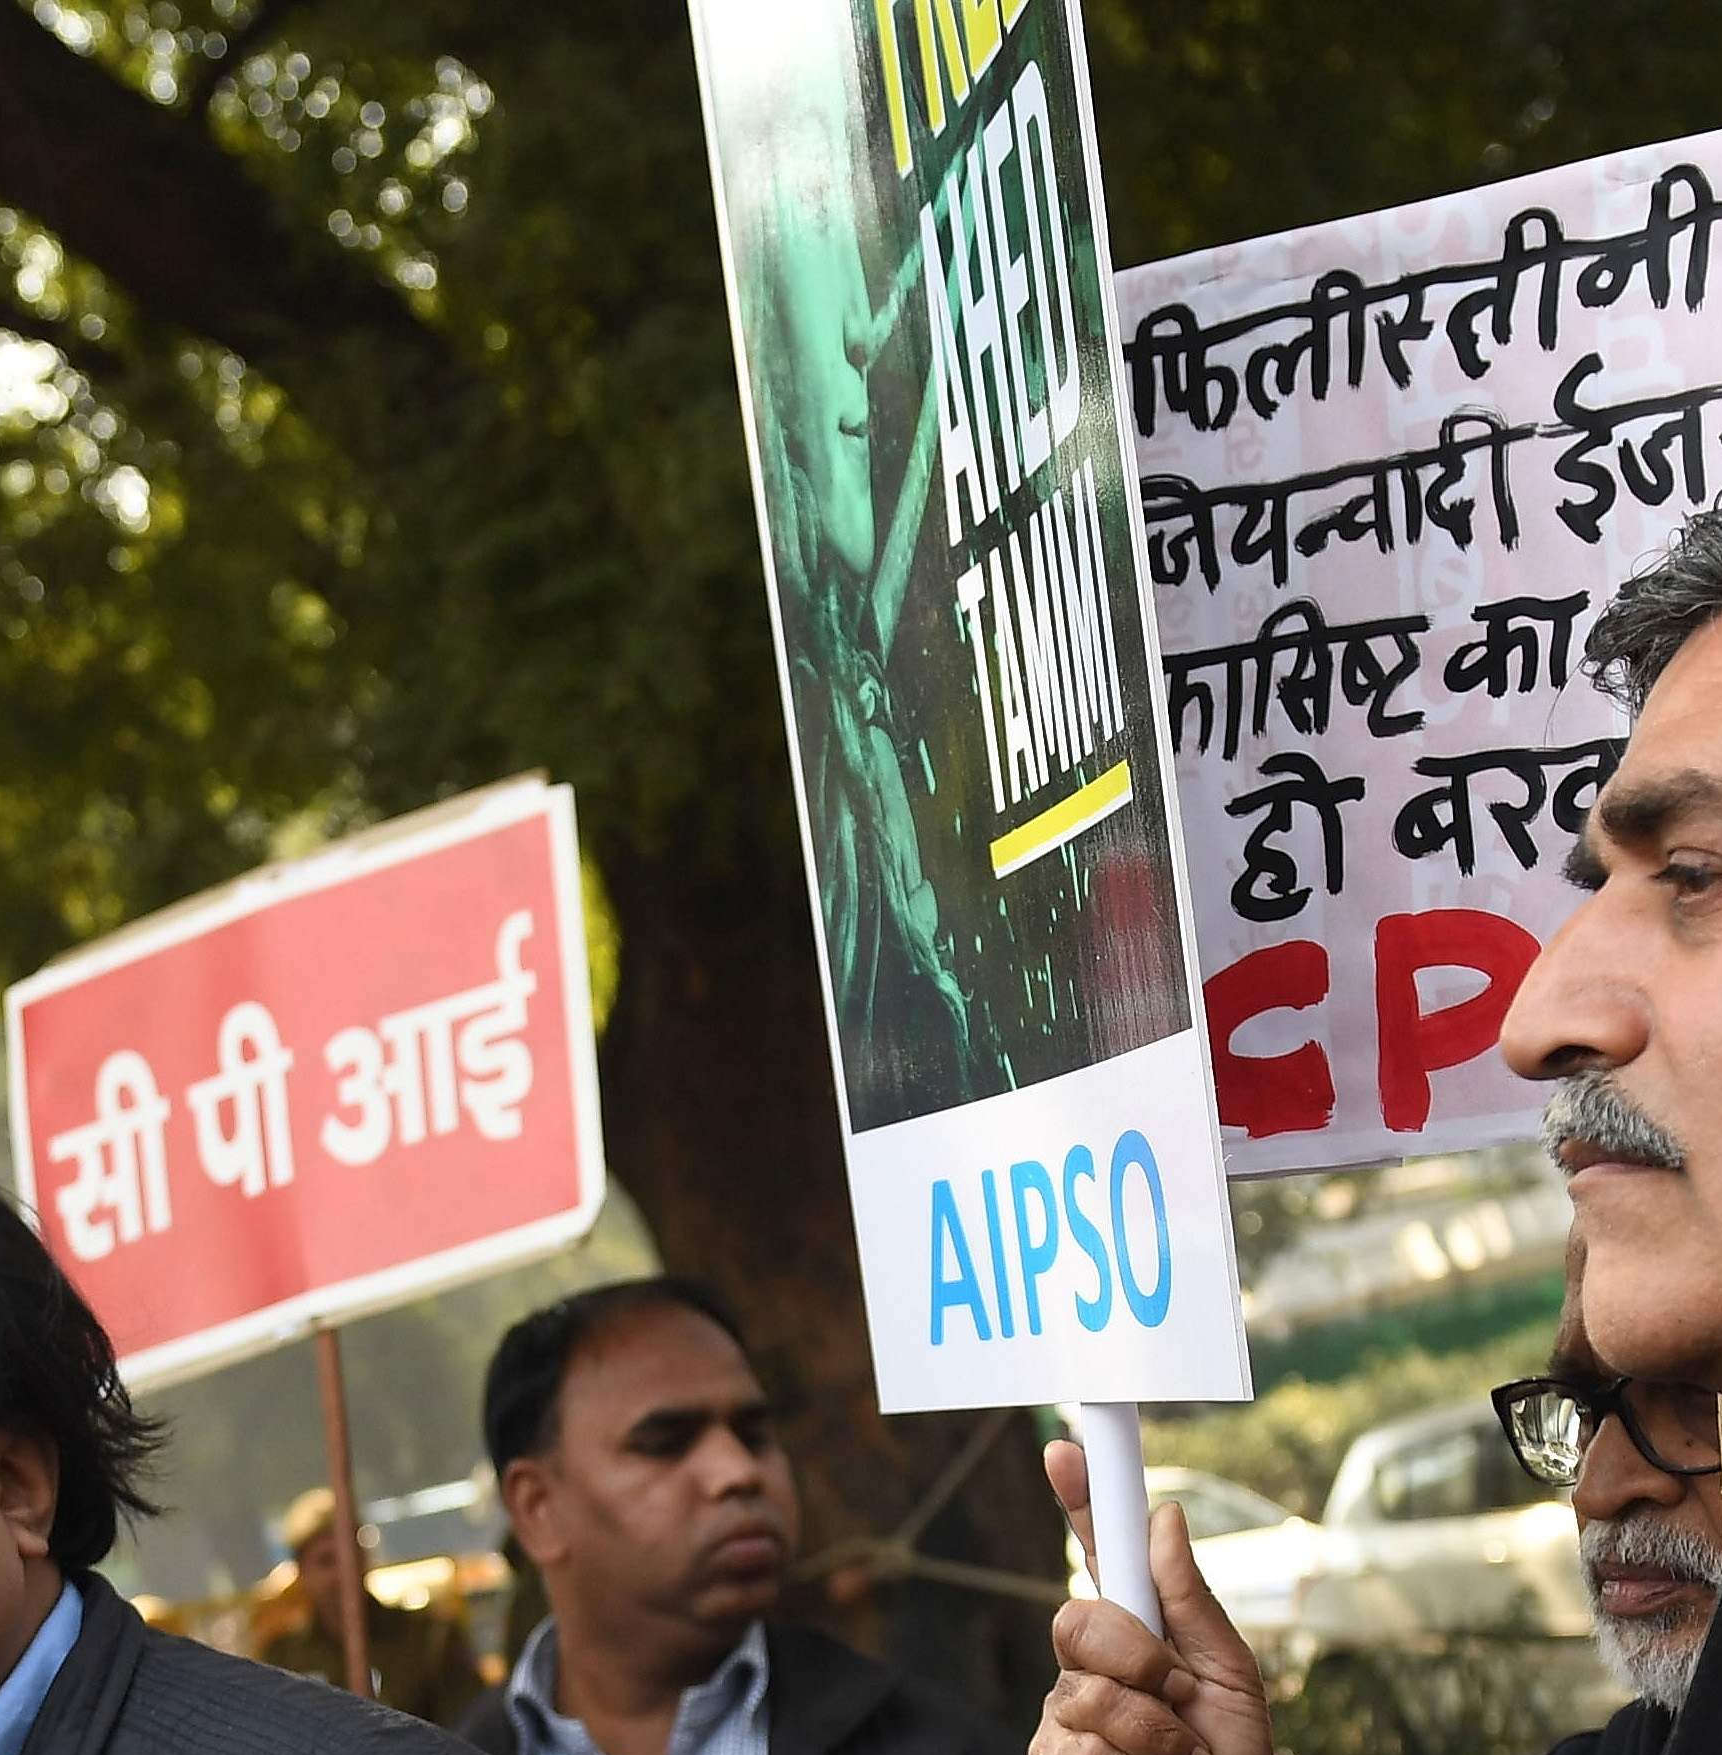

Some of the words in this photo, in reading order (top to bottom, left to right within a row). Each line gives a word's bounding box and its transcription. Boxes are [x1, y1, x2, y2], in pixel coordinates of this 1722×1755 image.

[921, 60, 1080, 547] AHED
[956, 456, 1126, 814] TAMIMI
[1224, 754, 1366, 923] हो
[47, 1049, 172, 1263] सी
[187, 1000, 296, 1199] पी
[319, 909, 538, 1167] आई
[930, 1129, 1172, 1346] AIPSO
